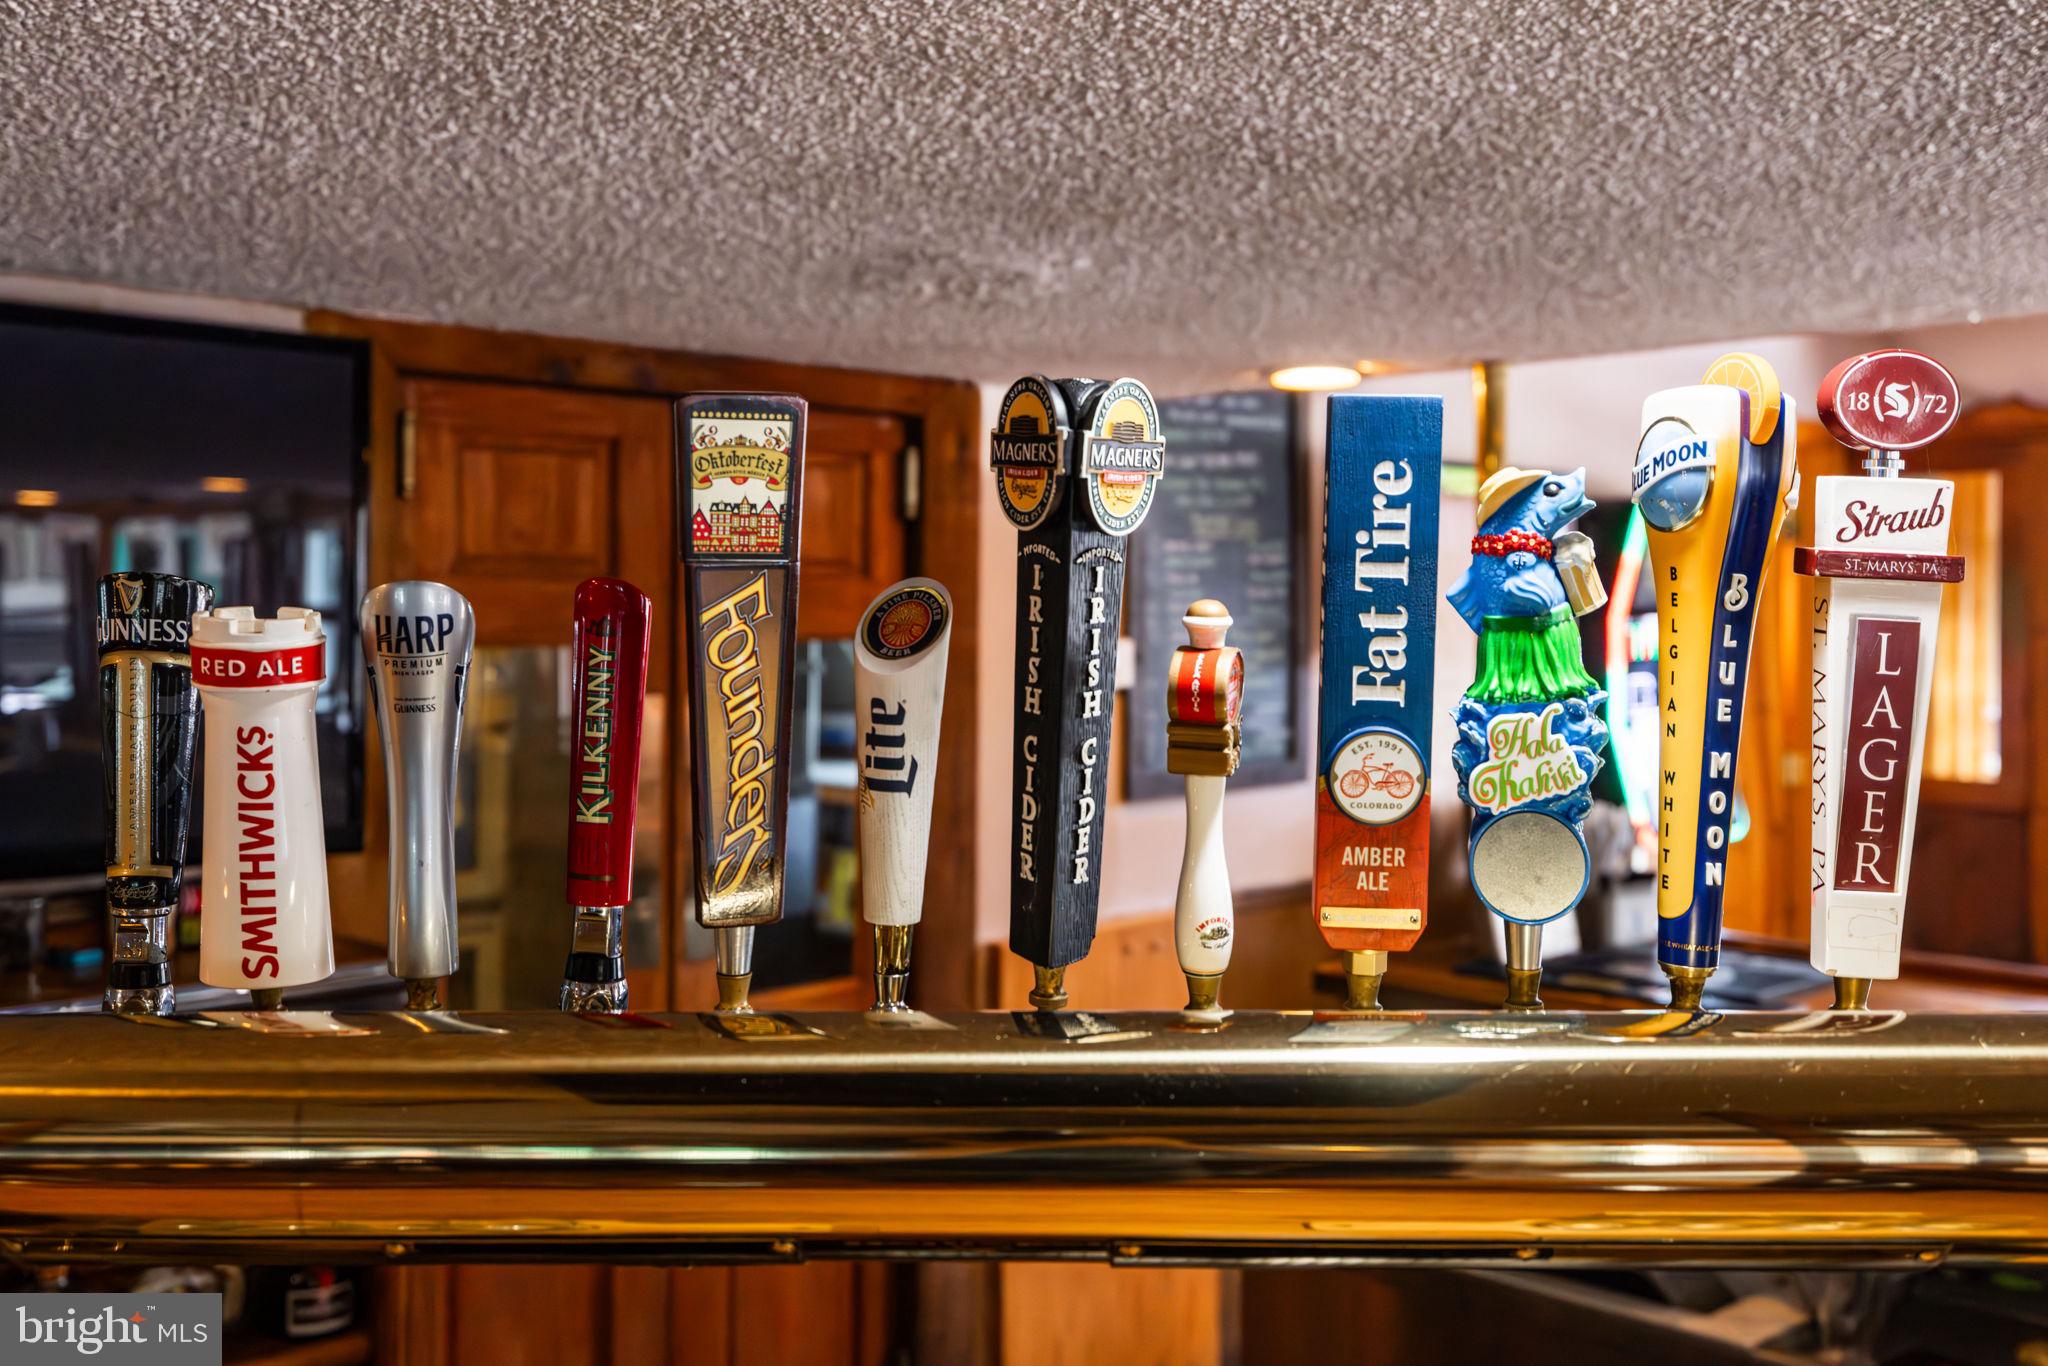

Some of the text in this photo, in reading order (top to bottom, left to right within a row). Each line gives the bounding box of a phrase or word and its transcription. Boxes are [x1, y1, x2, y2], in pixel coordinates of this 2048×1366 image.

[1847, 392, 1870, 411] 18
[1922, 394, 1948, 414] 72
[694, 450, 785, 475] Oktoberfest
[993, 439, 1056, 464] MAGNERS
[1090, 443, 1161, 470] MAGNERS
[1632, 441, 1708, 491] LUE MOON
[1835, 487, 1946, 543] Straub
[1082, 546, 1120, 562] IMPORTED
[1844, 558, 1862, 571] ST.
[1922, 562, 1938, 575] PA
[1351, 457, 1415, 708] Fat Tire
[96, 615, 189, 644] GUINNESS
[374, 613, 454, 654] HARP
[1812, 596, 1829, 649] ST.
[128, 656, 138, 713] DUBLIN
[200, 655, 304, 678] RED ALE
[384, 658, 443, 669] PREMIUM
[393, 703, 436, 714] GUINNESS
[1019, 563, 1044, 882] IRISH CIDER
[1073, 565, 1106, 885] IRISH CIDER
[1661, 566, 1679, 890] BELGIAN WHITE
[1704, 573, 1749, 887] BLUE MOON
[576, 643, 617, 825] KILKENNY
[699, 570, 778, 897] Founders
[864, 697, 919, 799] Lite
[1351, 740, 1404, 756] EST. 1991
[1490, 708, 1564, 760] Hala
[1851, 631, 1902, 885] LAGER
[1473, 755, 1583, 812] Kahiki
[1350, 801, 1403, 811] COLORADO
[1341, 846, 1406, 868] AMBER
[1812, 847, 1829, 894] PA
[1356, 871, 1390, 892] ALE
